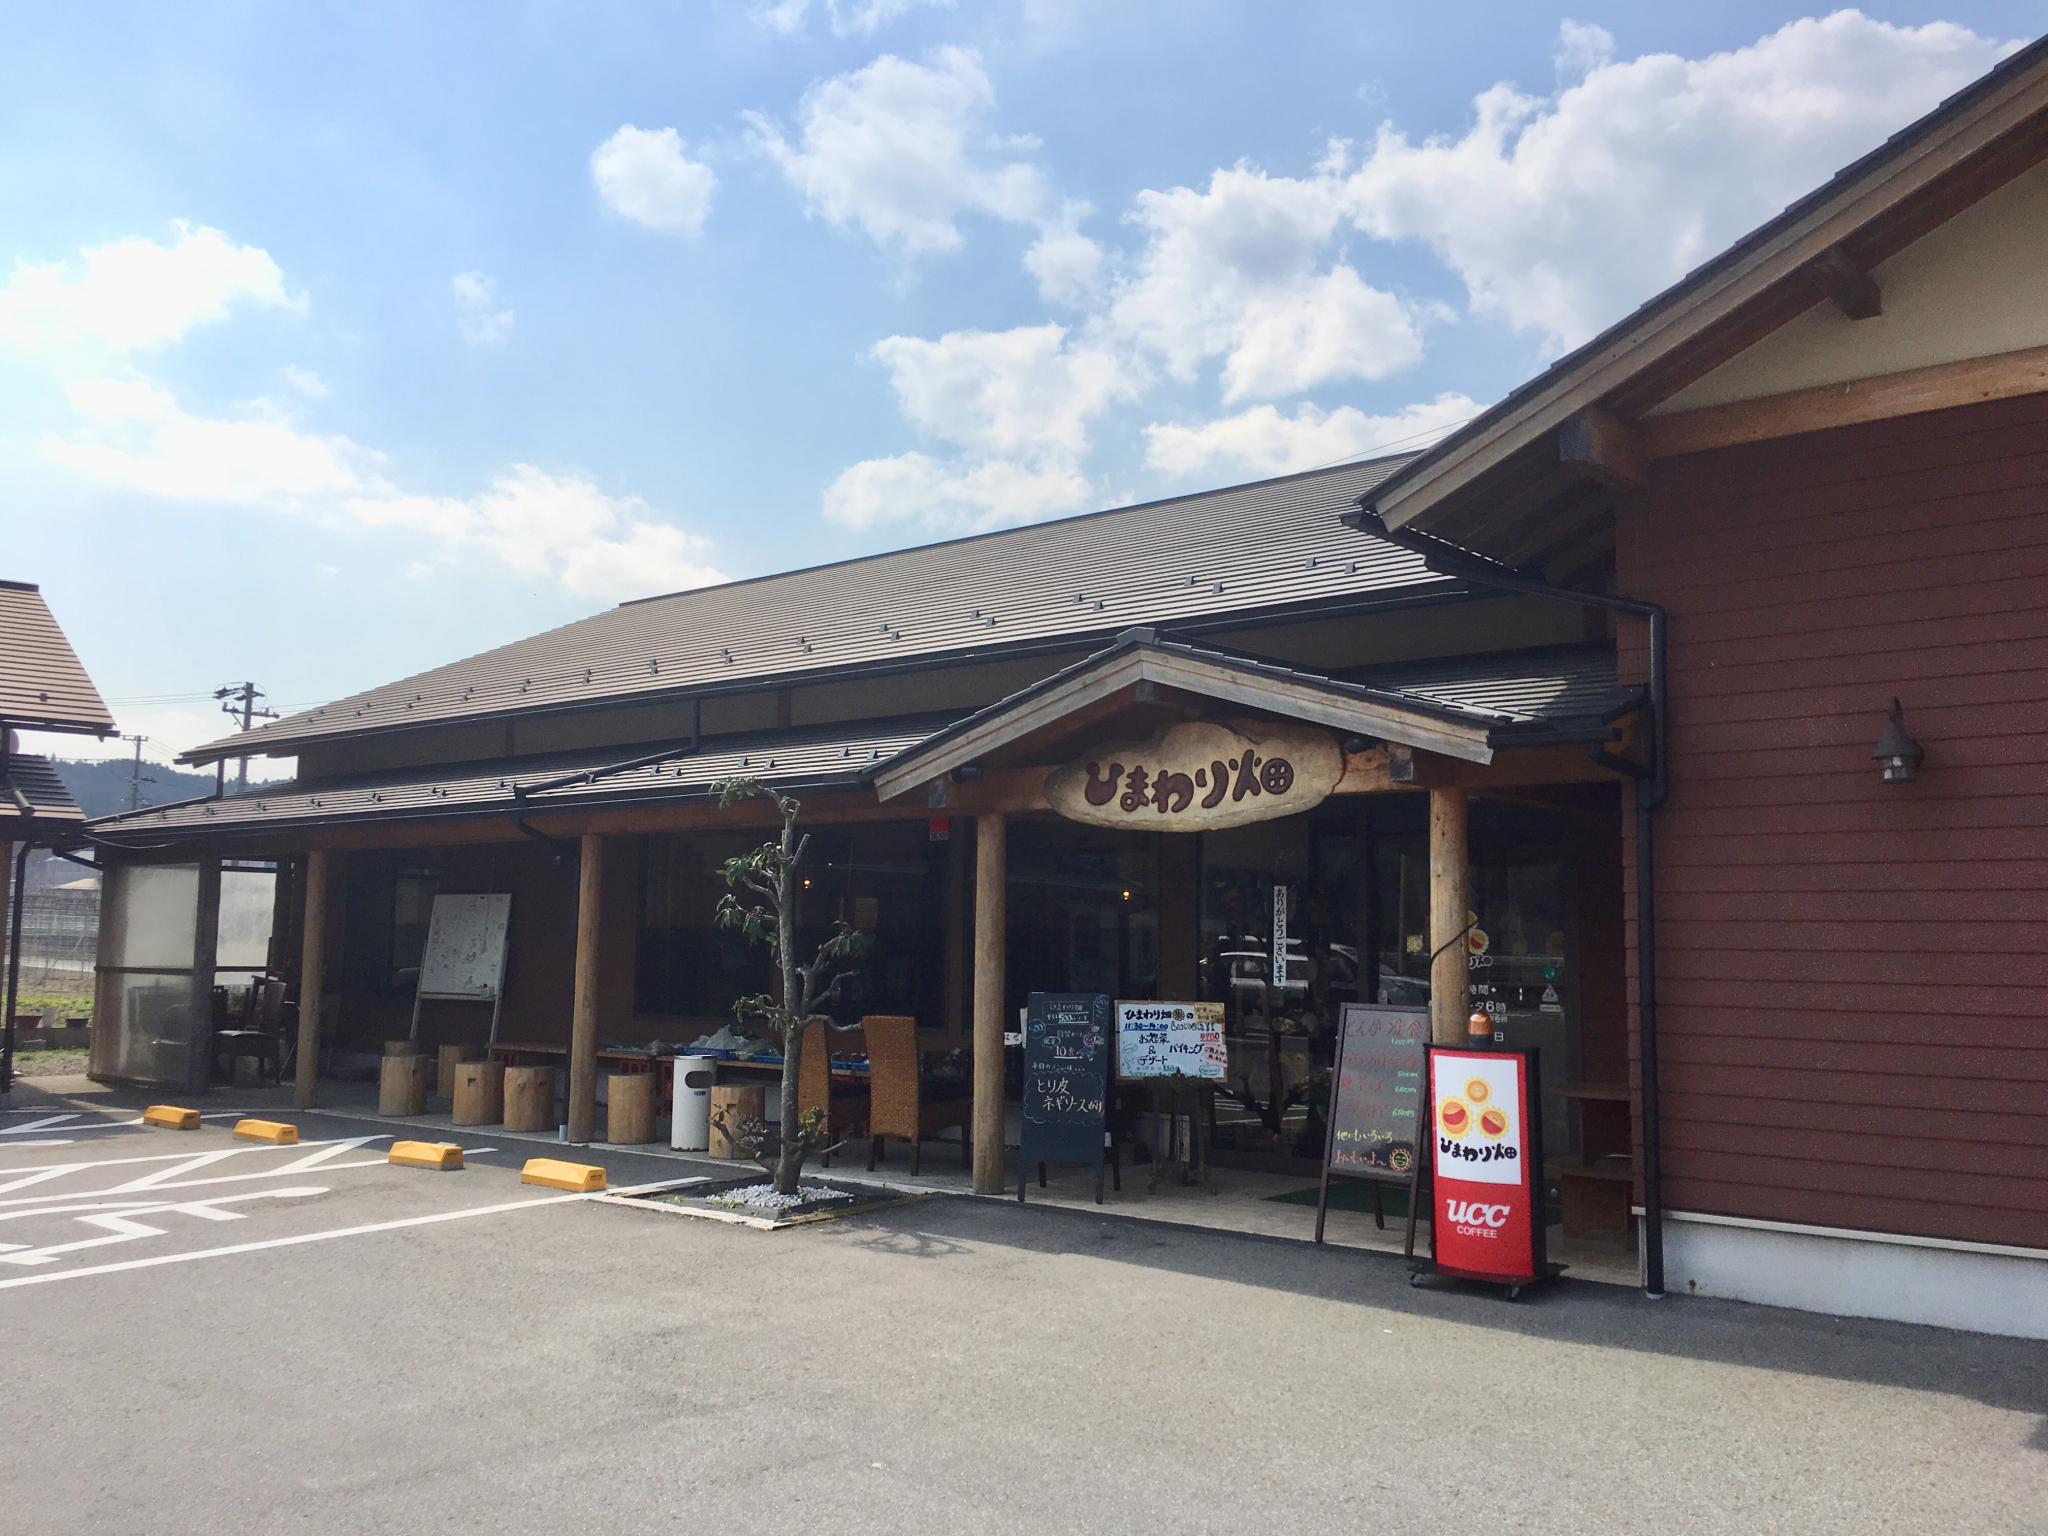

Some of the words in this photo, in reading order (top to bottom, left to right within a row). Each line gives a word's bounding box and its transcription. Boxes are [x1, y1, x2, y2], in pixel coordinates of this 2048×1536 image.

[1084, 749, 1295, 814] ひまわり畑
[1275, 888, 1285, 983] ありがとうございます
[1124, 1008, 1172, 1020] ひまわり畑
[1186, 1012, 1194, 1020] の
[1138, 1032, 1170, 1045] お惣菜
[1148, 1046, 1157, 1055] &
[1169, 1044, 1205, 1054] バイキング
[1139, 1056, 1168, 1065] デザート
[1037, 1077, 1071, 1095] とり皮
[1440, 1137, 1518, 1163] ひまわり畑
[1456, 1225, 1498, 1239] COFFEE
